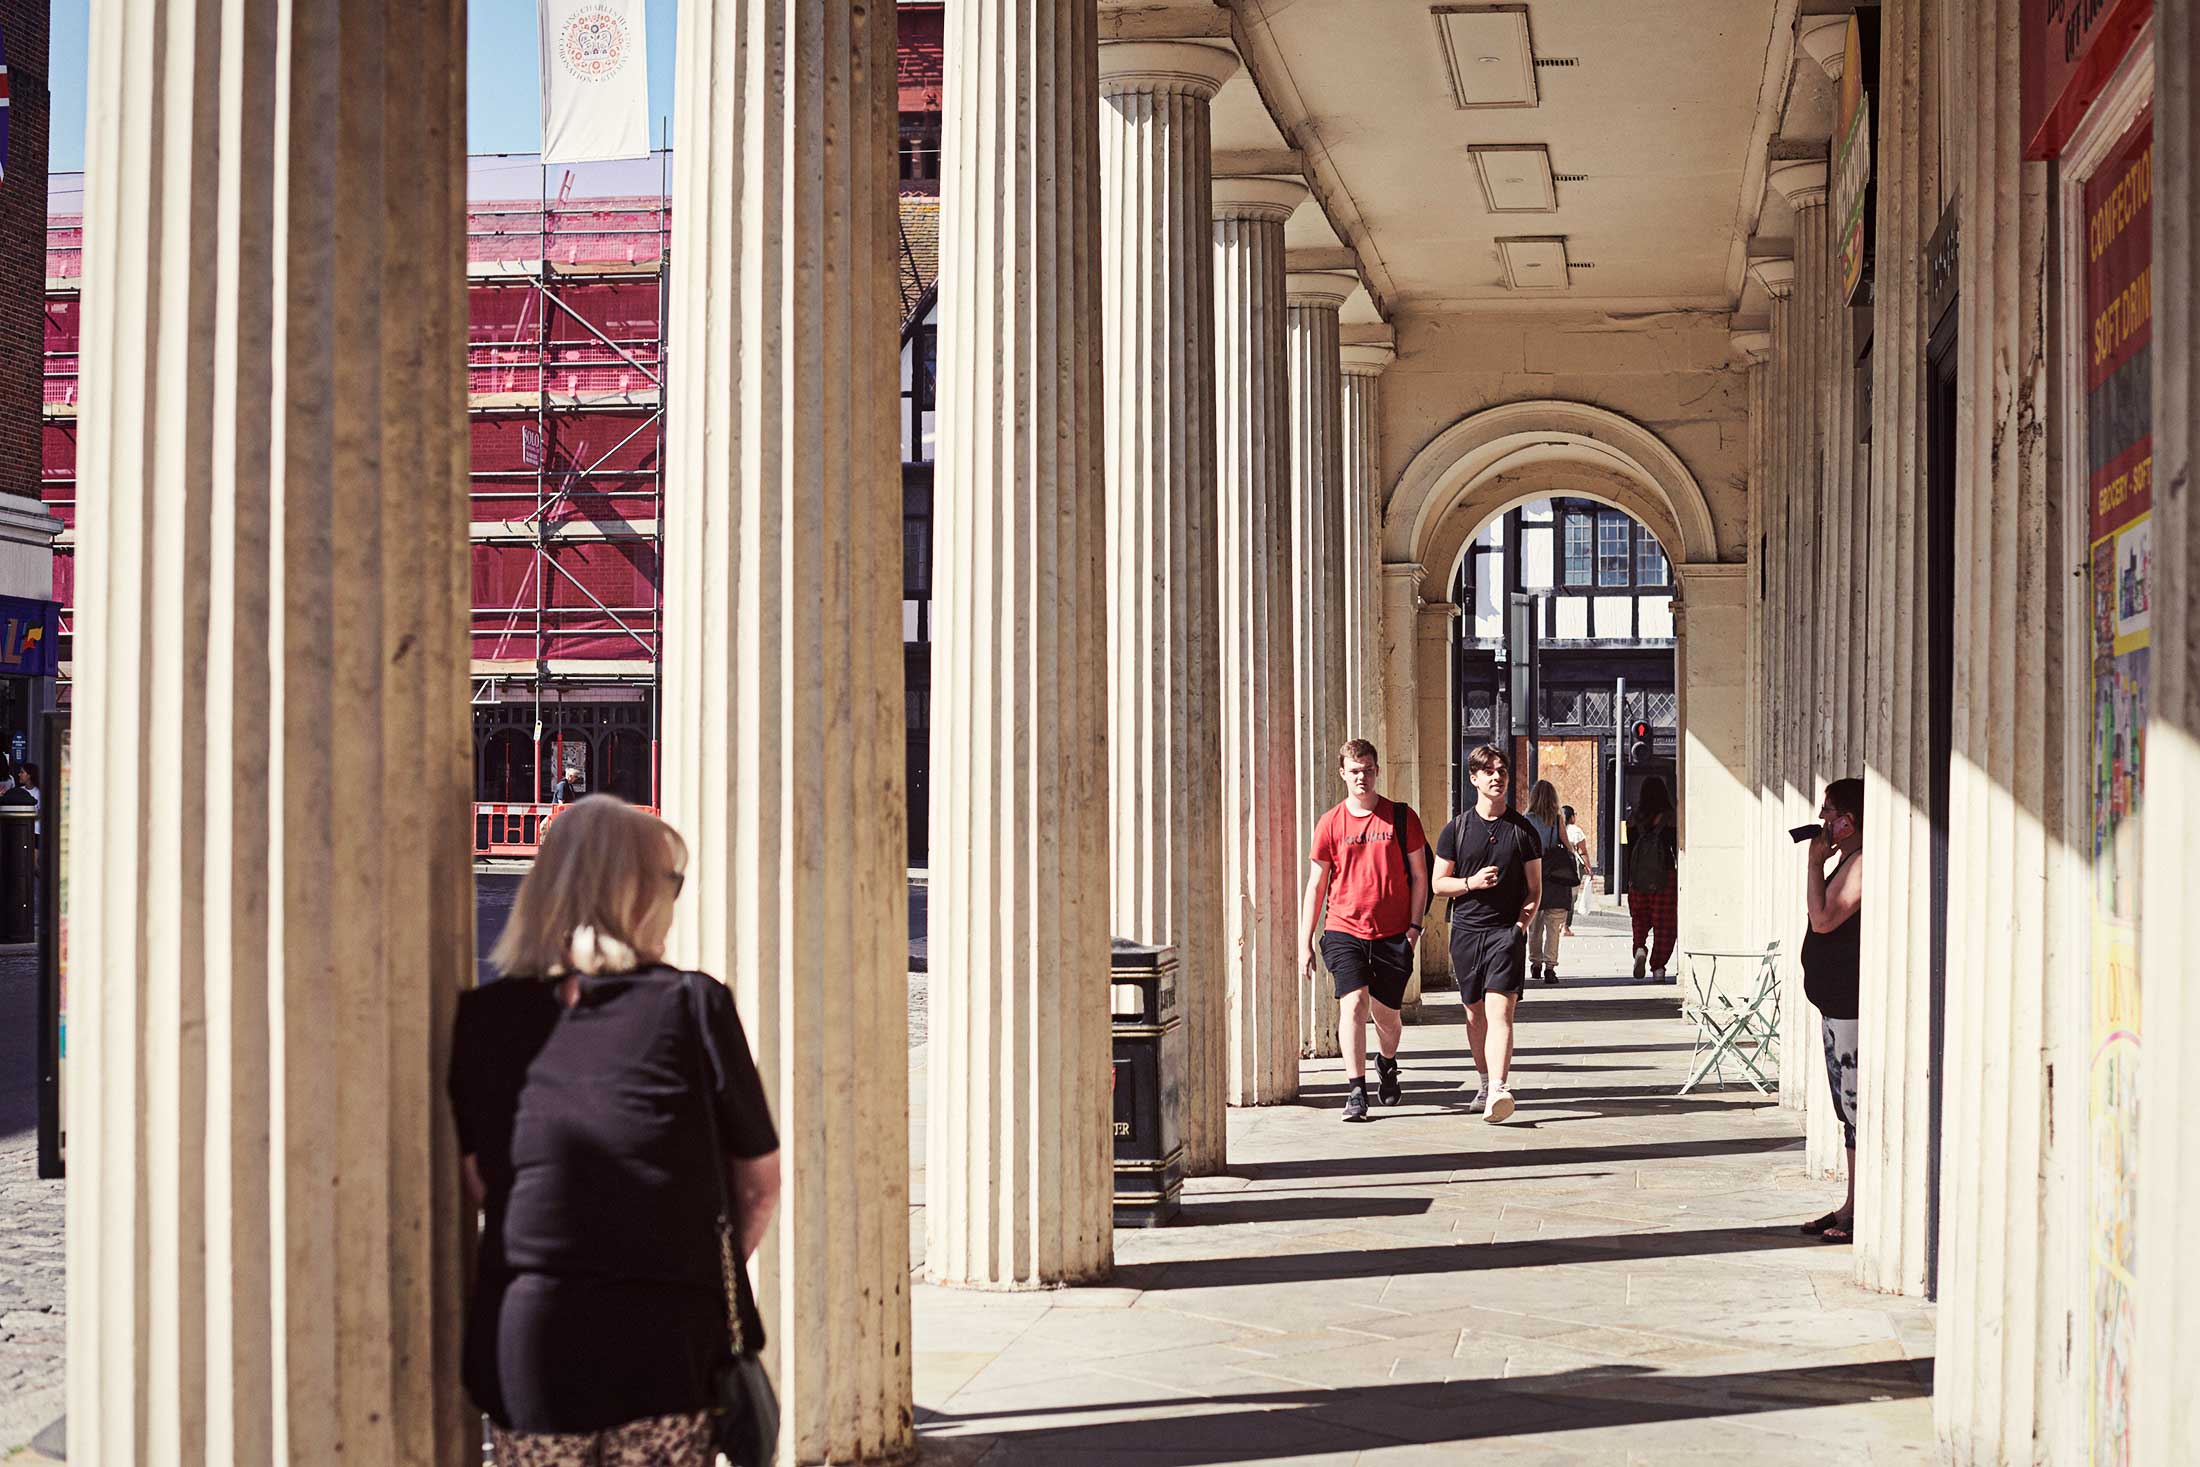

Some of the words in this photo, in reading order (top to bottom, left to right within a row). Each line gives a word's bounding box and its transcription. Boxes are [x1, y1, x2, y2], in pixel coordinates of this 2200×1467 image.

[580, 4, 617, 16] CHARLES
[2095, 296, 2121, 366] SOFT
[525, 428, 540, 448] SOLO
